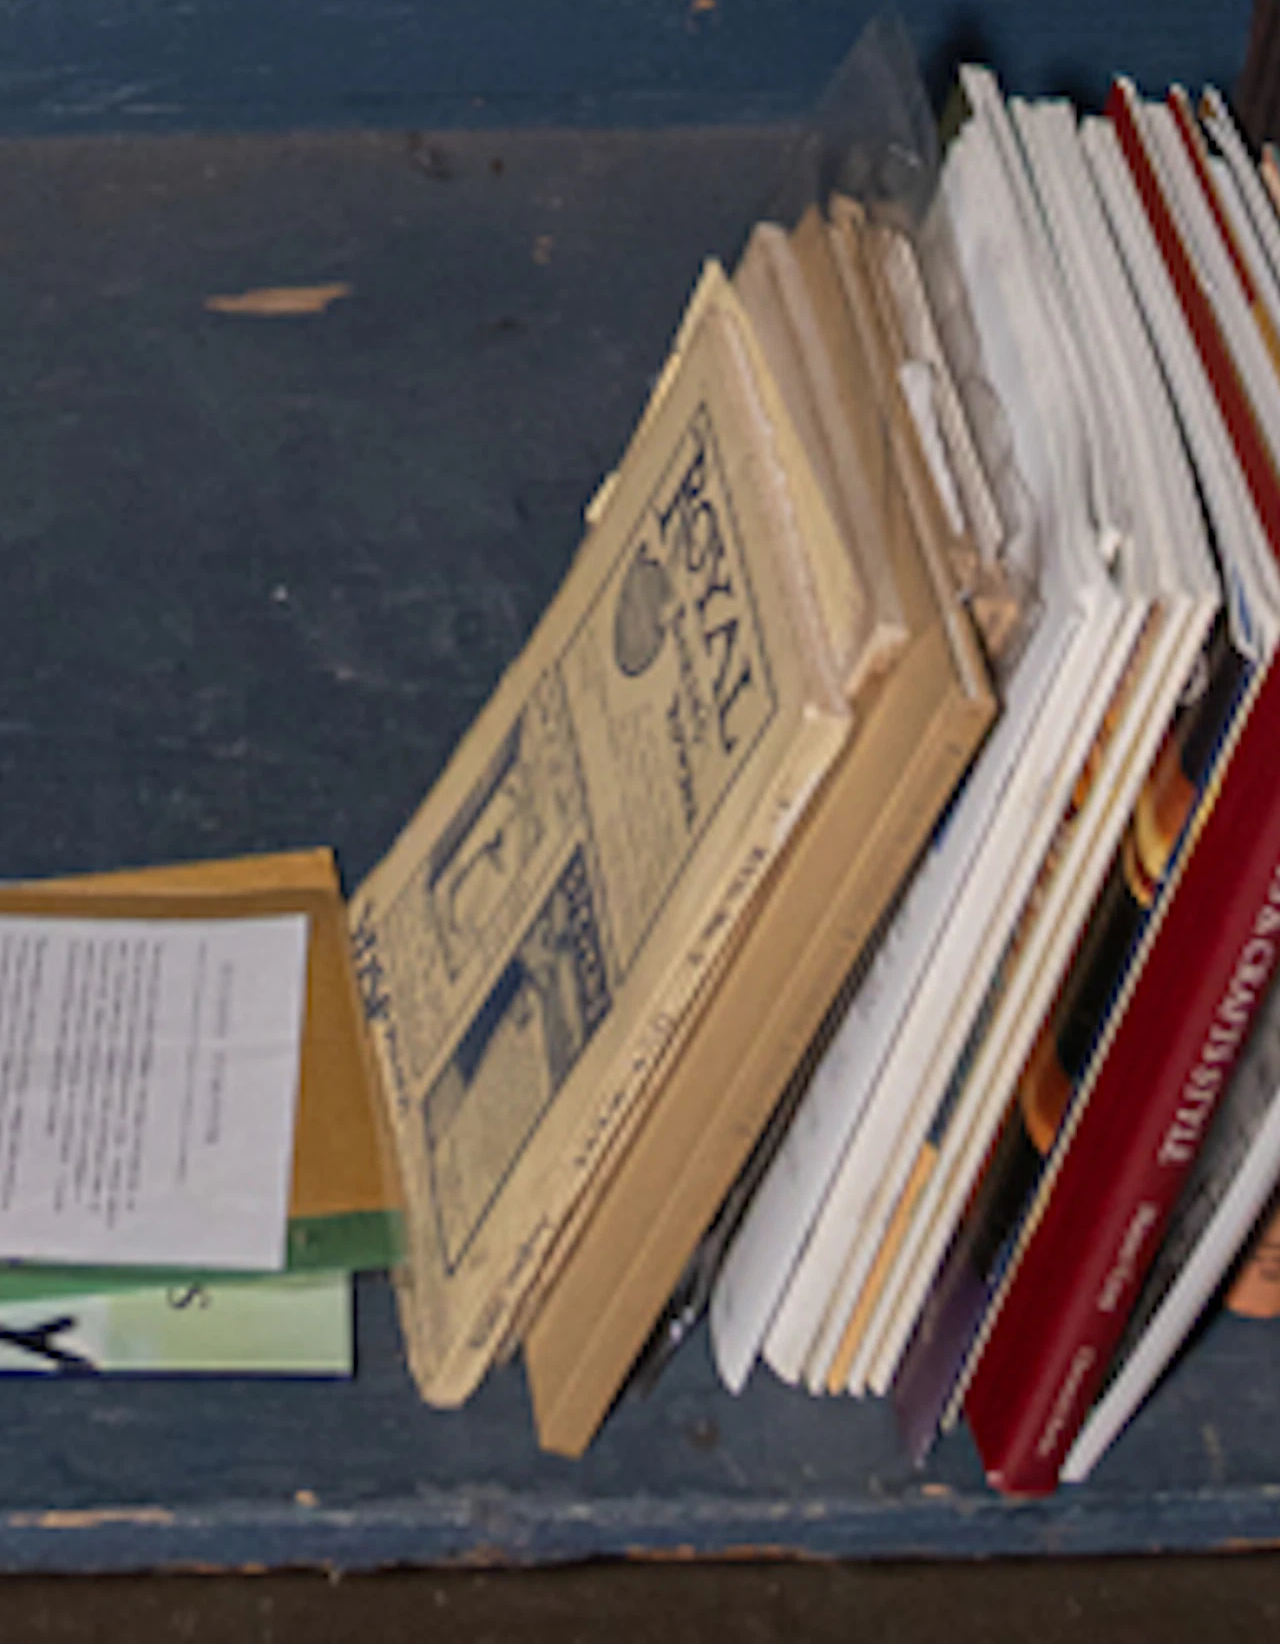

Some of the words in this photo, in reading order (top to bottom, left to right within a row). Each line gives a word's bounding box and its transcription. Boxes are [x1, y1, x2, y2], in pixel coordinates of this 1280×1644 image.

[658, 449, 753, 759] ROYAL
[1198, 931, 1277, 1067] CRAFTS
[1153, 1060, 1222, 1172] STYLE
